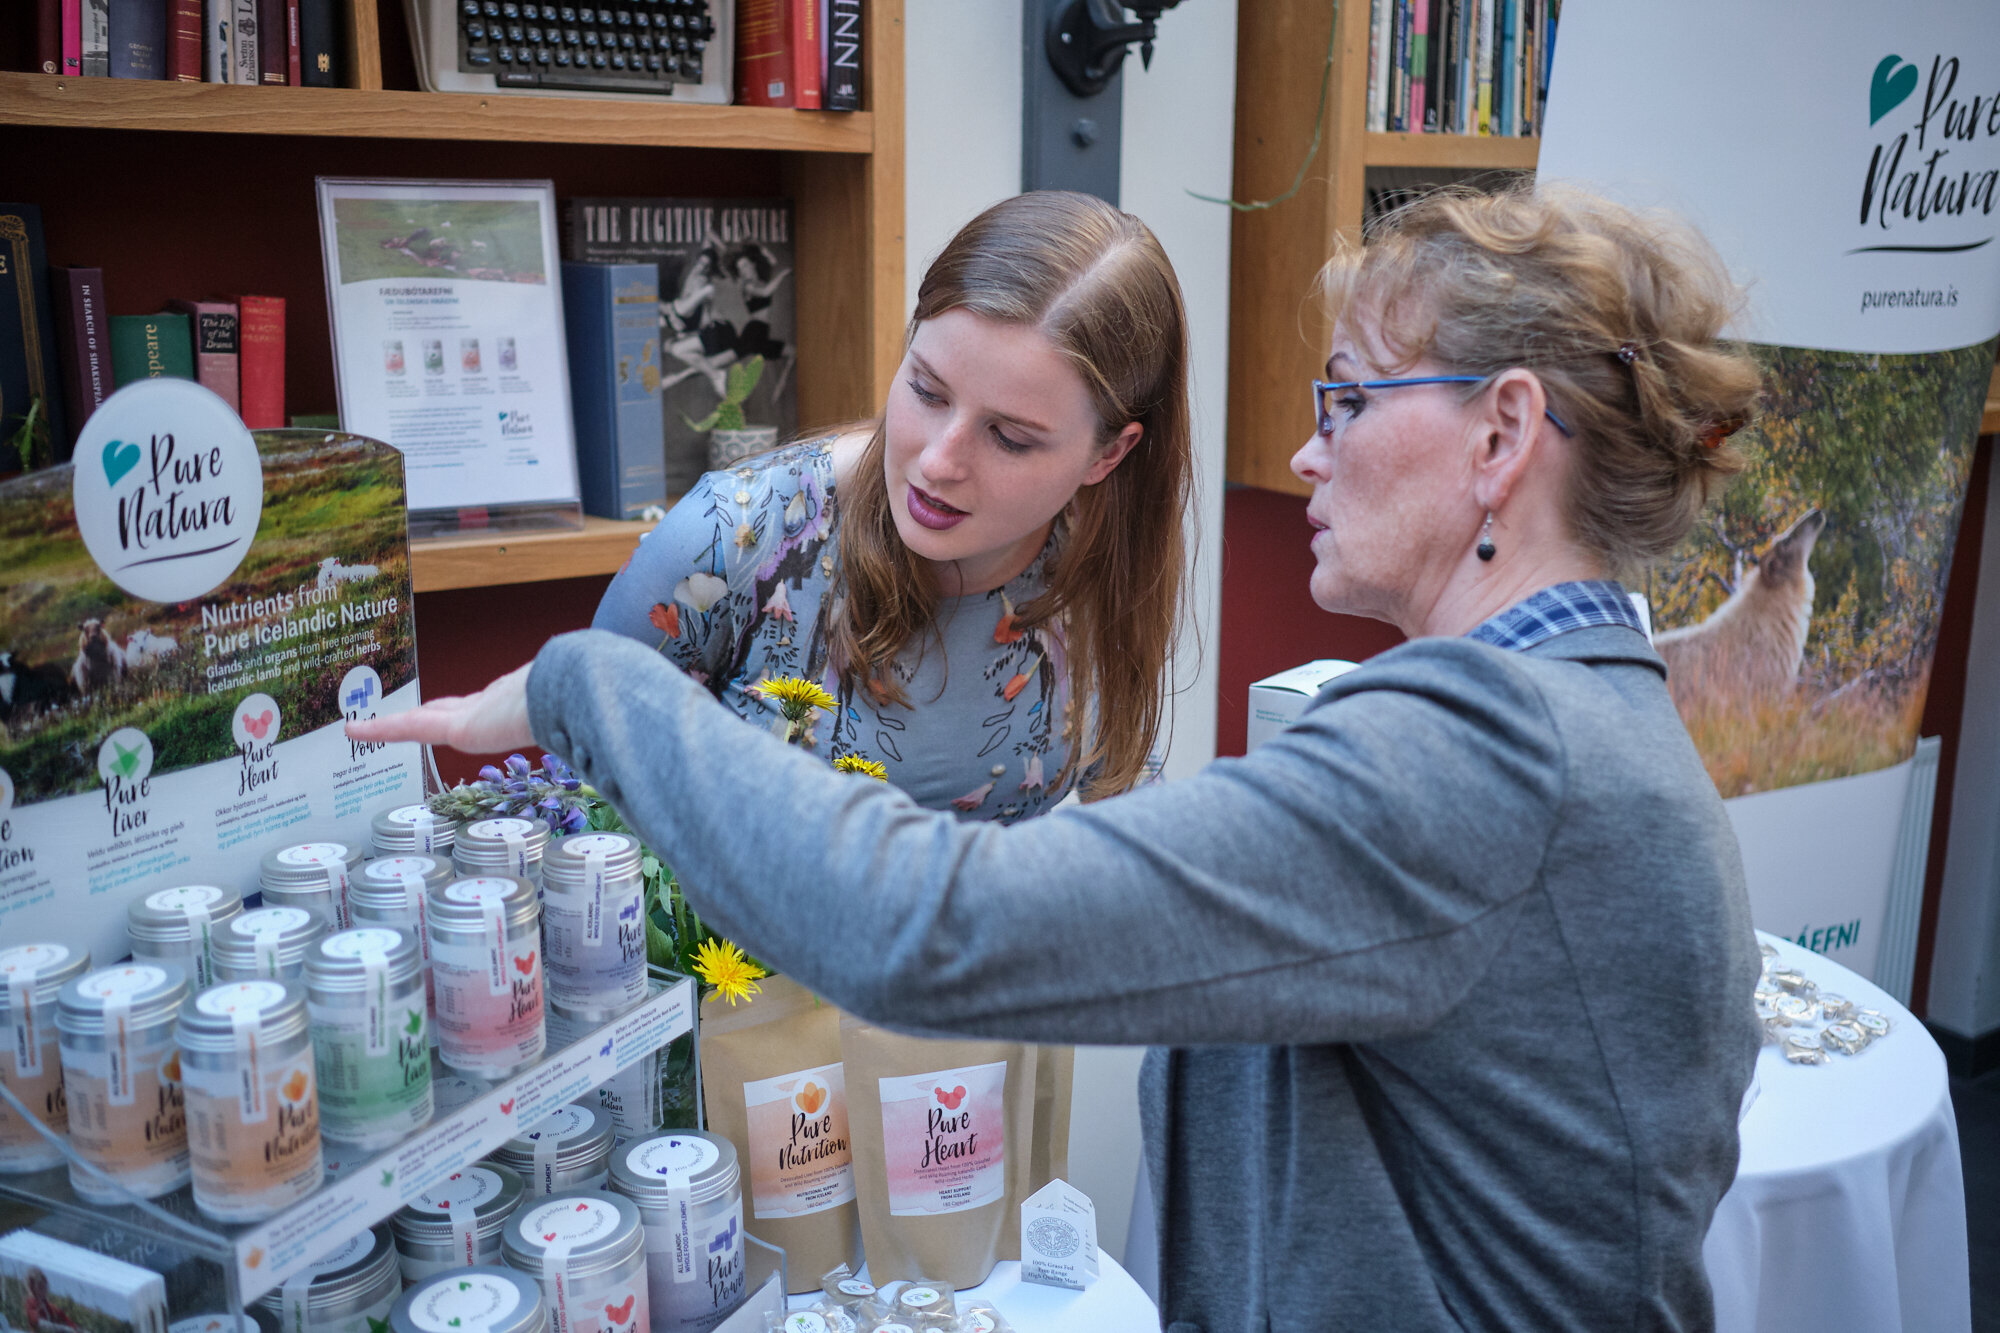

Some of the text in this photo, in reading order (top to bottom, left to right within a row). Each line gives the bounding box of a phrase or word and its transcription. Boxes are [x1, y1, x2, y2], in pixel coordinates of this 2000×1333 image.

[1914, 54, 2000, 150] Pure
[1860, 133, 2000, 229] Natura
[585, 207, 620, 242] THE
[630, 207, 713, 242] FUGITIVE
[82, 284, 90, 296] IN
[1861, 285, 1958, 313] purenatura.is
[84, 297, 94, 336] SEARCH
[202, 319, 218, 328] The
[88, 338, 96, 350] OF
[206, 340, 233, 348] Drama
[208, 330, 230, 339] of the
[145, 324, 164, 378] speare
[148, 434, 222, 496] Pure
[118, 486, 236, 550] Natura
[201, 585, 338, 630] Nutrients from
[204, 596, 398, 658] Pure Icelandic Nature
[206, 628, 374, 679] Glands and organs from free roaming
[208, 640, 381, 694] Icelandic lamb and wild-crafted herbs
[242, 741, 274, 770] Pure
[104, 774, 152, 814] Pure
[238, 760, 280, 796] Heart
[112, 806, 151, 838] Liver
[215, 808, 232, 818] Okkar
[618, 923, 642, 948] Pure
[1783, 919, 1861, 954] ÁEFNI
[512, 978, 536, 1002] Pure
[508, 992, 538, 1023] Heart
[398, 1036, 427, 1068] Pure
[606, 1090, 622, 1102] Pure
[278, 1102, 312, 1138] Pure
[790, 1112, 832, 1146] Pure
[926, 1108, 970, 1140] Pure
[780, 1138, 846, 1170] Nutrition
[921, 1132, 978, 1168] Heart
[796, 1182, 839, 1198] NUTRITIONAL SUPPORT
[821, 1172, 837, 1180] Icelandic
[817, 1191, 832, 1199] ICELAND
[706, 1251, 738, 1288] Pure
[1028, 1271, 1041, 1279] High
[1043, 1273, 1063, 1282] Quality
[1051, 1268, 1067, 1277] Range
[556, 1272, 565, 1310] SUPPLEMENT
[712, 1270, 744, 1308] Powe
